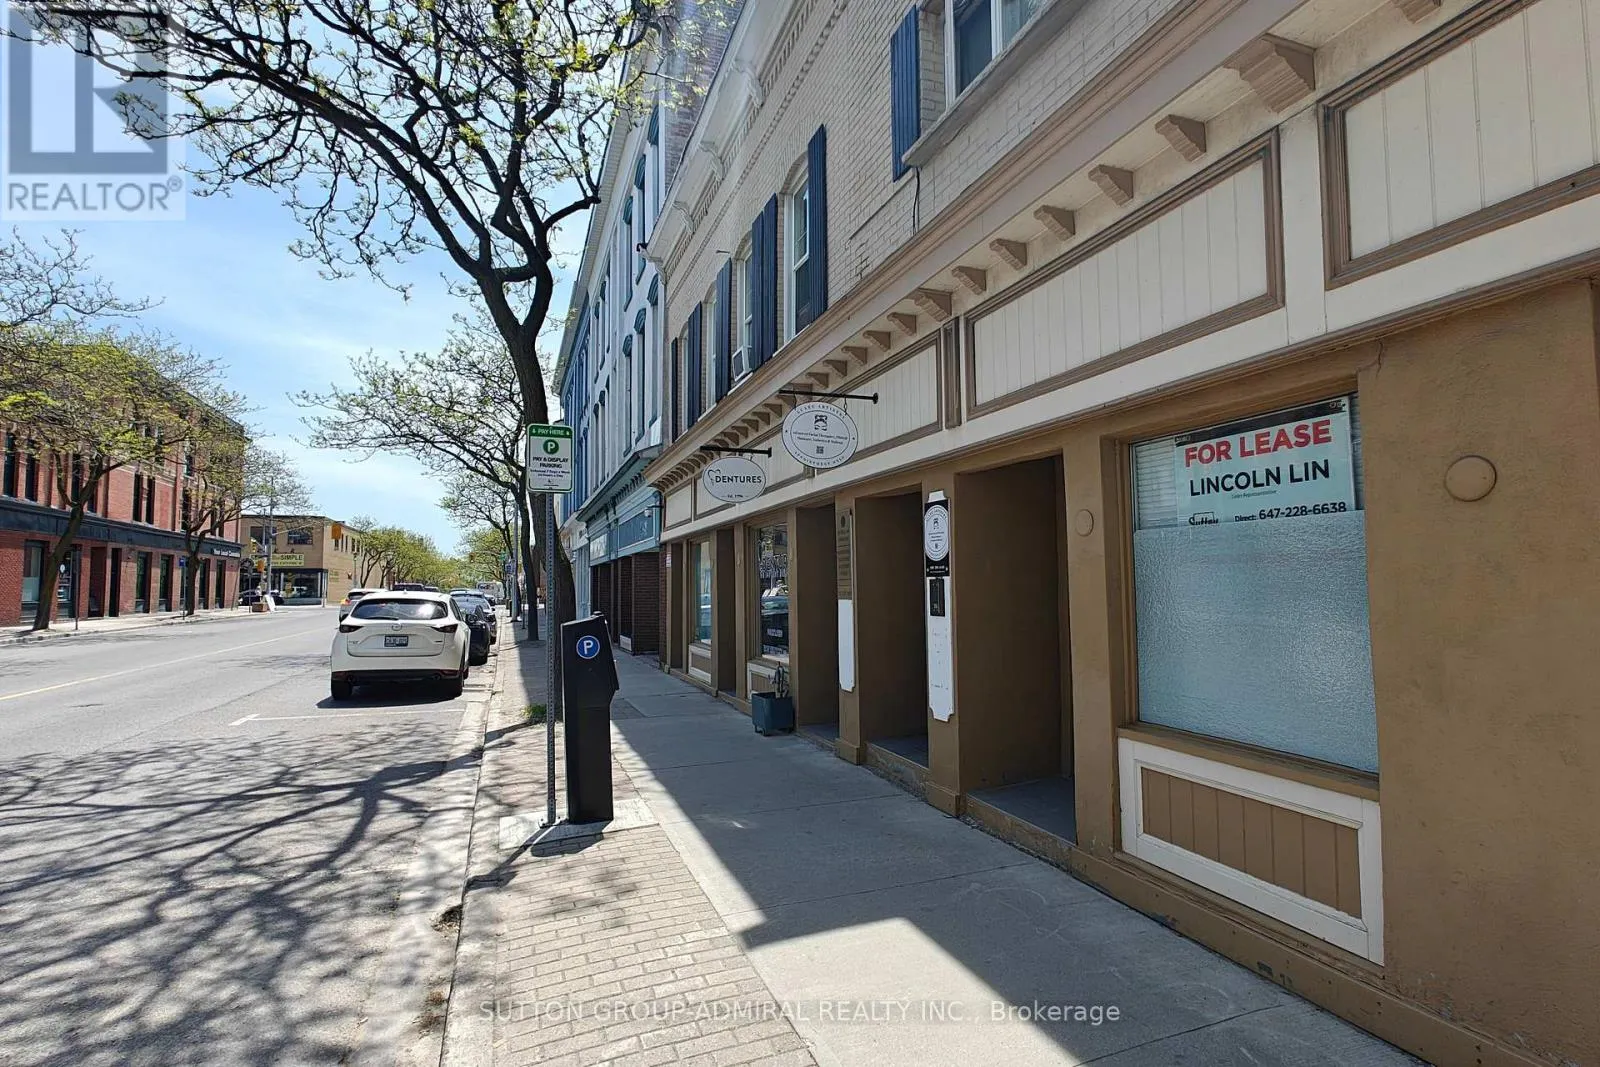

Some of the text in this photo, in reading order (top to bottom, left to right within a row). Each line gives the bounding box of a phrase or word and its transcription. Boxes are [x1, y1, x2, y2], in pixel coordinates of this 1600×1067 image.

[548, 442, 556, 452] P
[1184, 419, 1332, 467] FOR LEASE
[715, 475, 762, 484] DENTURES
[1190, 459, 1330, 497] LINCOLN LIN
[1258, 501, 1347, 520] 647-228-6638
[583, 640, 594, 655] P
